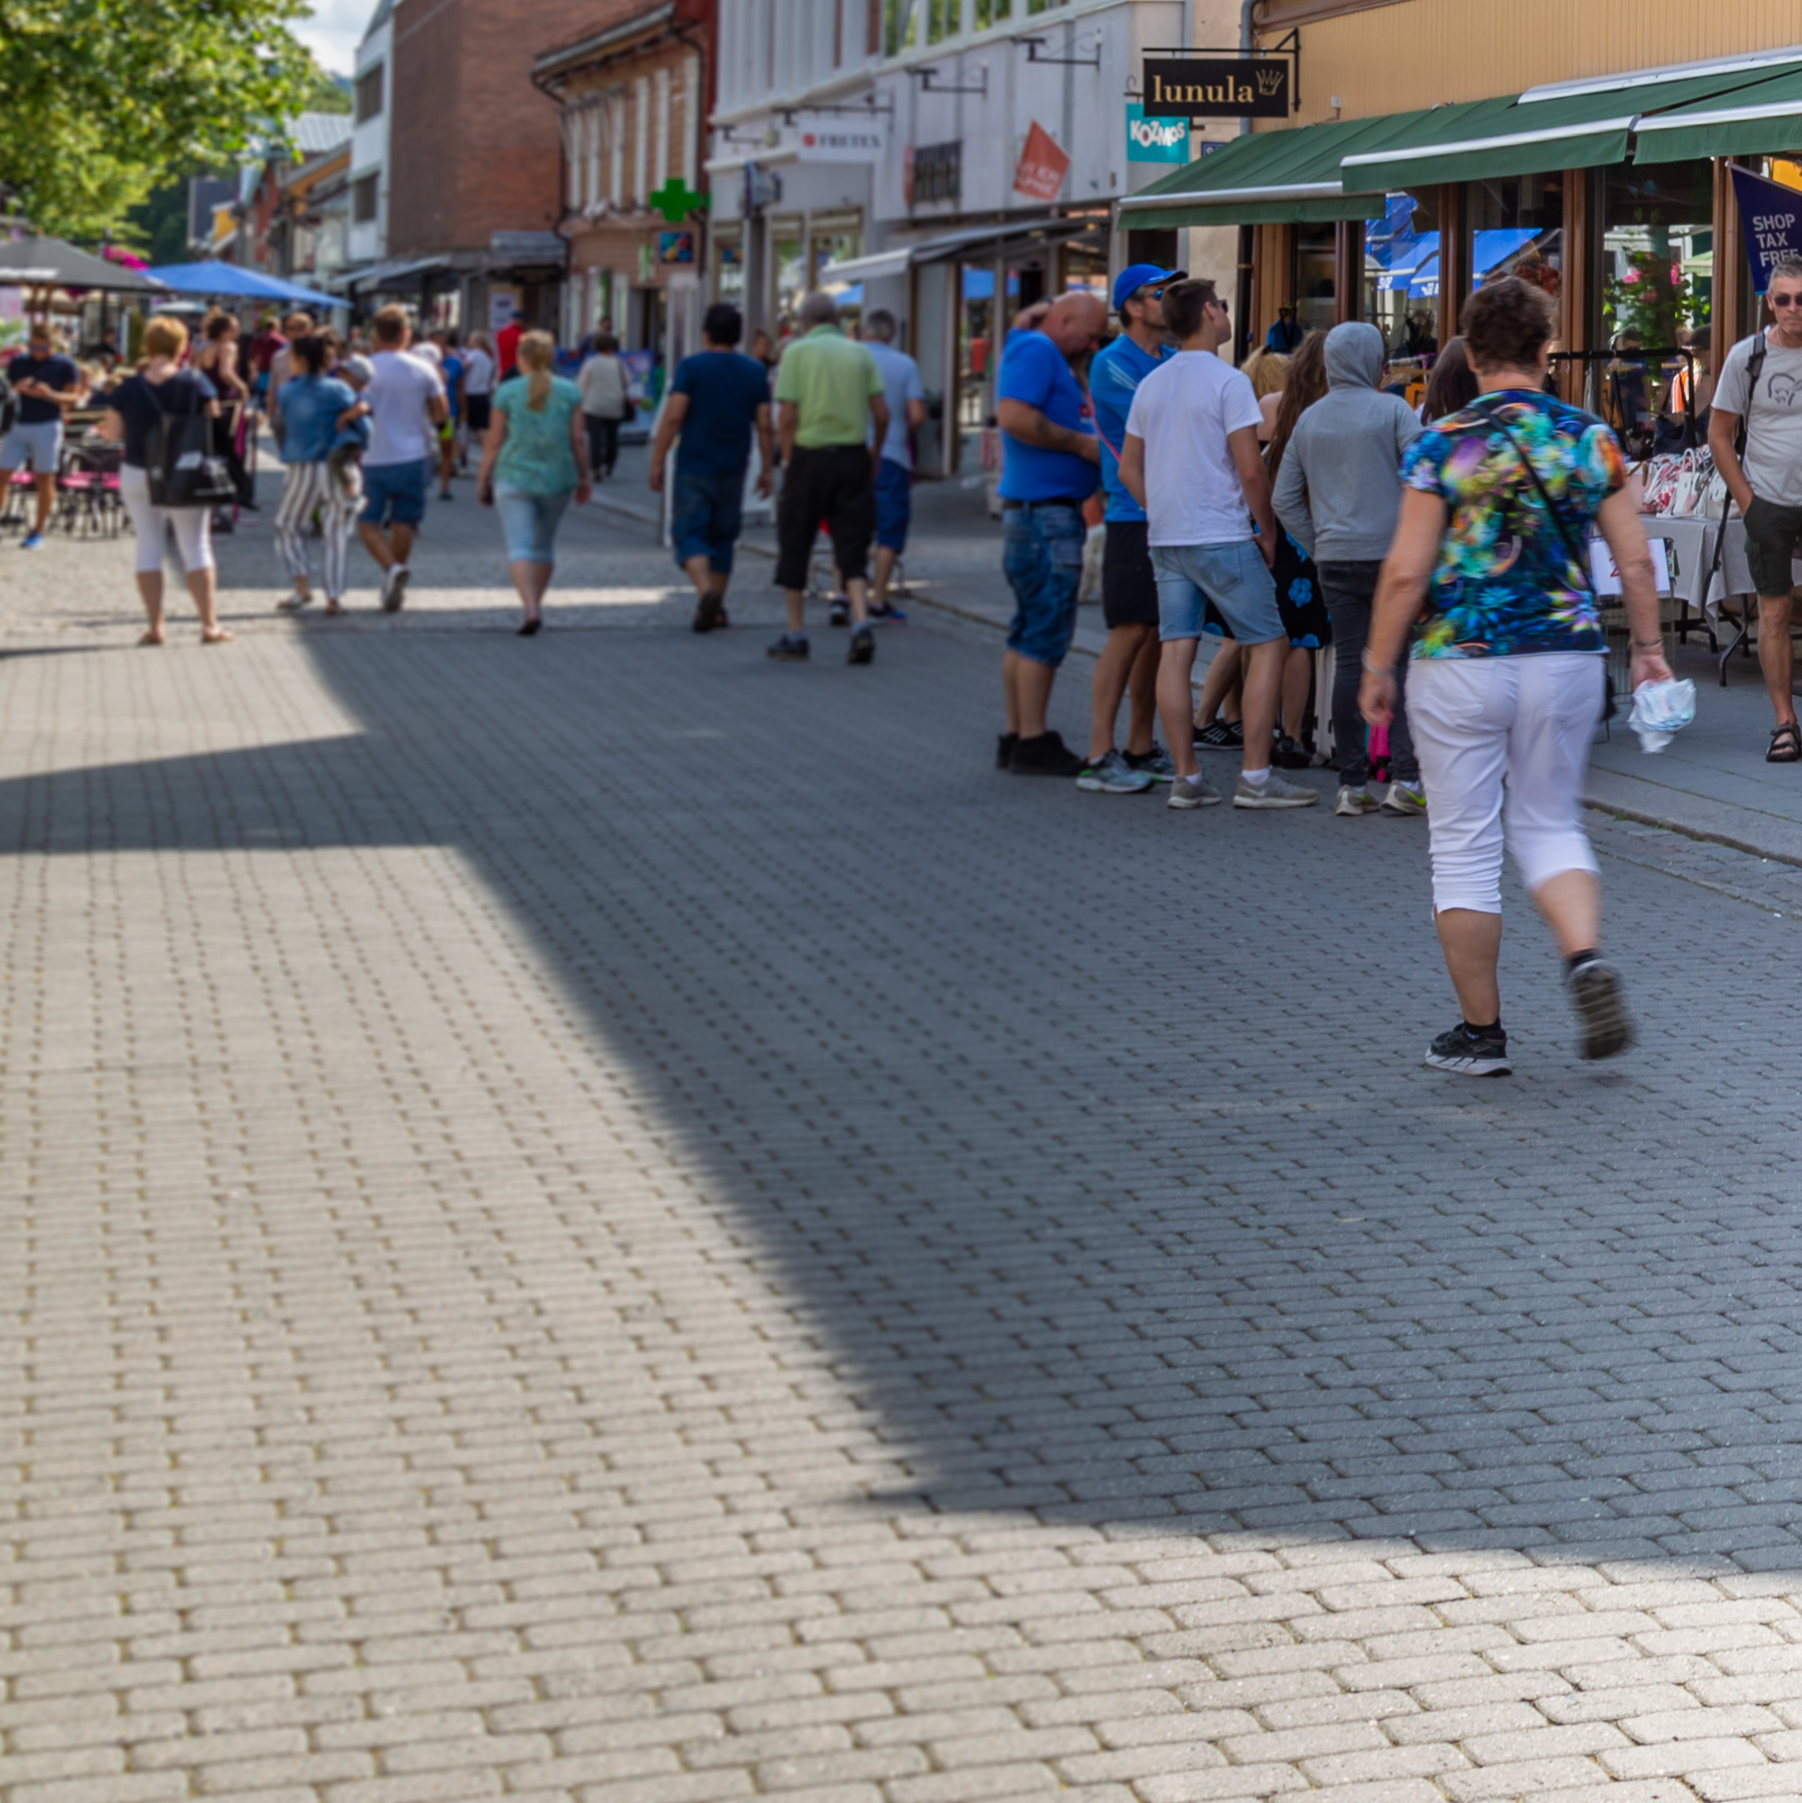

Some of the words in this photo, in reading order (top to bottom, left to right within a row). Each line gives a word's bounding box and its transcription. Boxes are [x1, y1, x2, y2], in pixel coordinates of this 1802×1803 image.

[1153, 75, 1254, 103] lunula
[1752, 214, 1796, 231] SHOP
[1755, 232, 1788, 249] TAX
